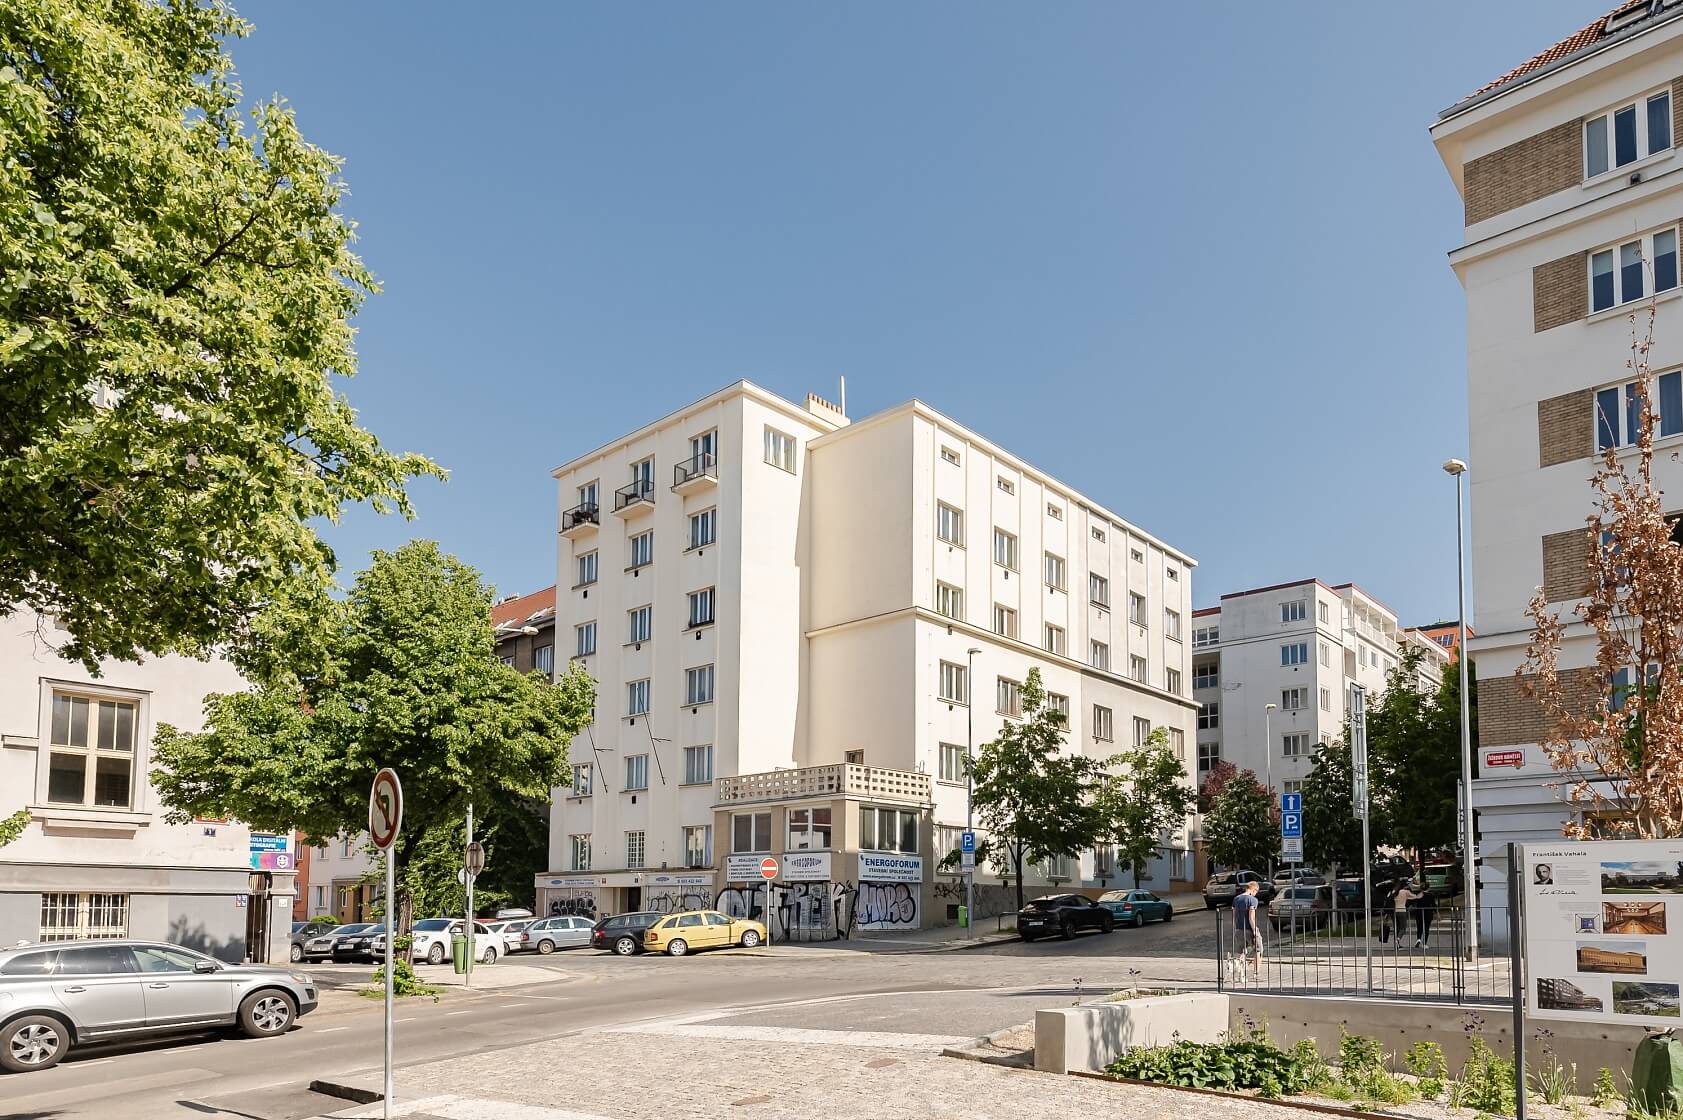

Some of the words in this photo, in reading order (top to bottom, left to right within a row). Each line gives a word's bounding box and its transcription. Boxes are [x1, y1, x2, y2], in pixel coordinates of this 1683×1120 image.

[1286, 815, 1297, 829] P
[964, 835, 972, 846] P
[865, 858, 920, 869] ENERGOFORUM
